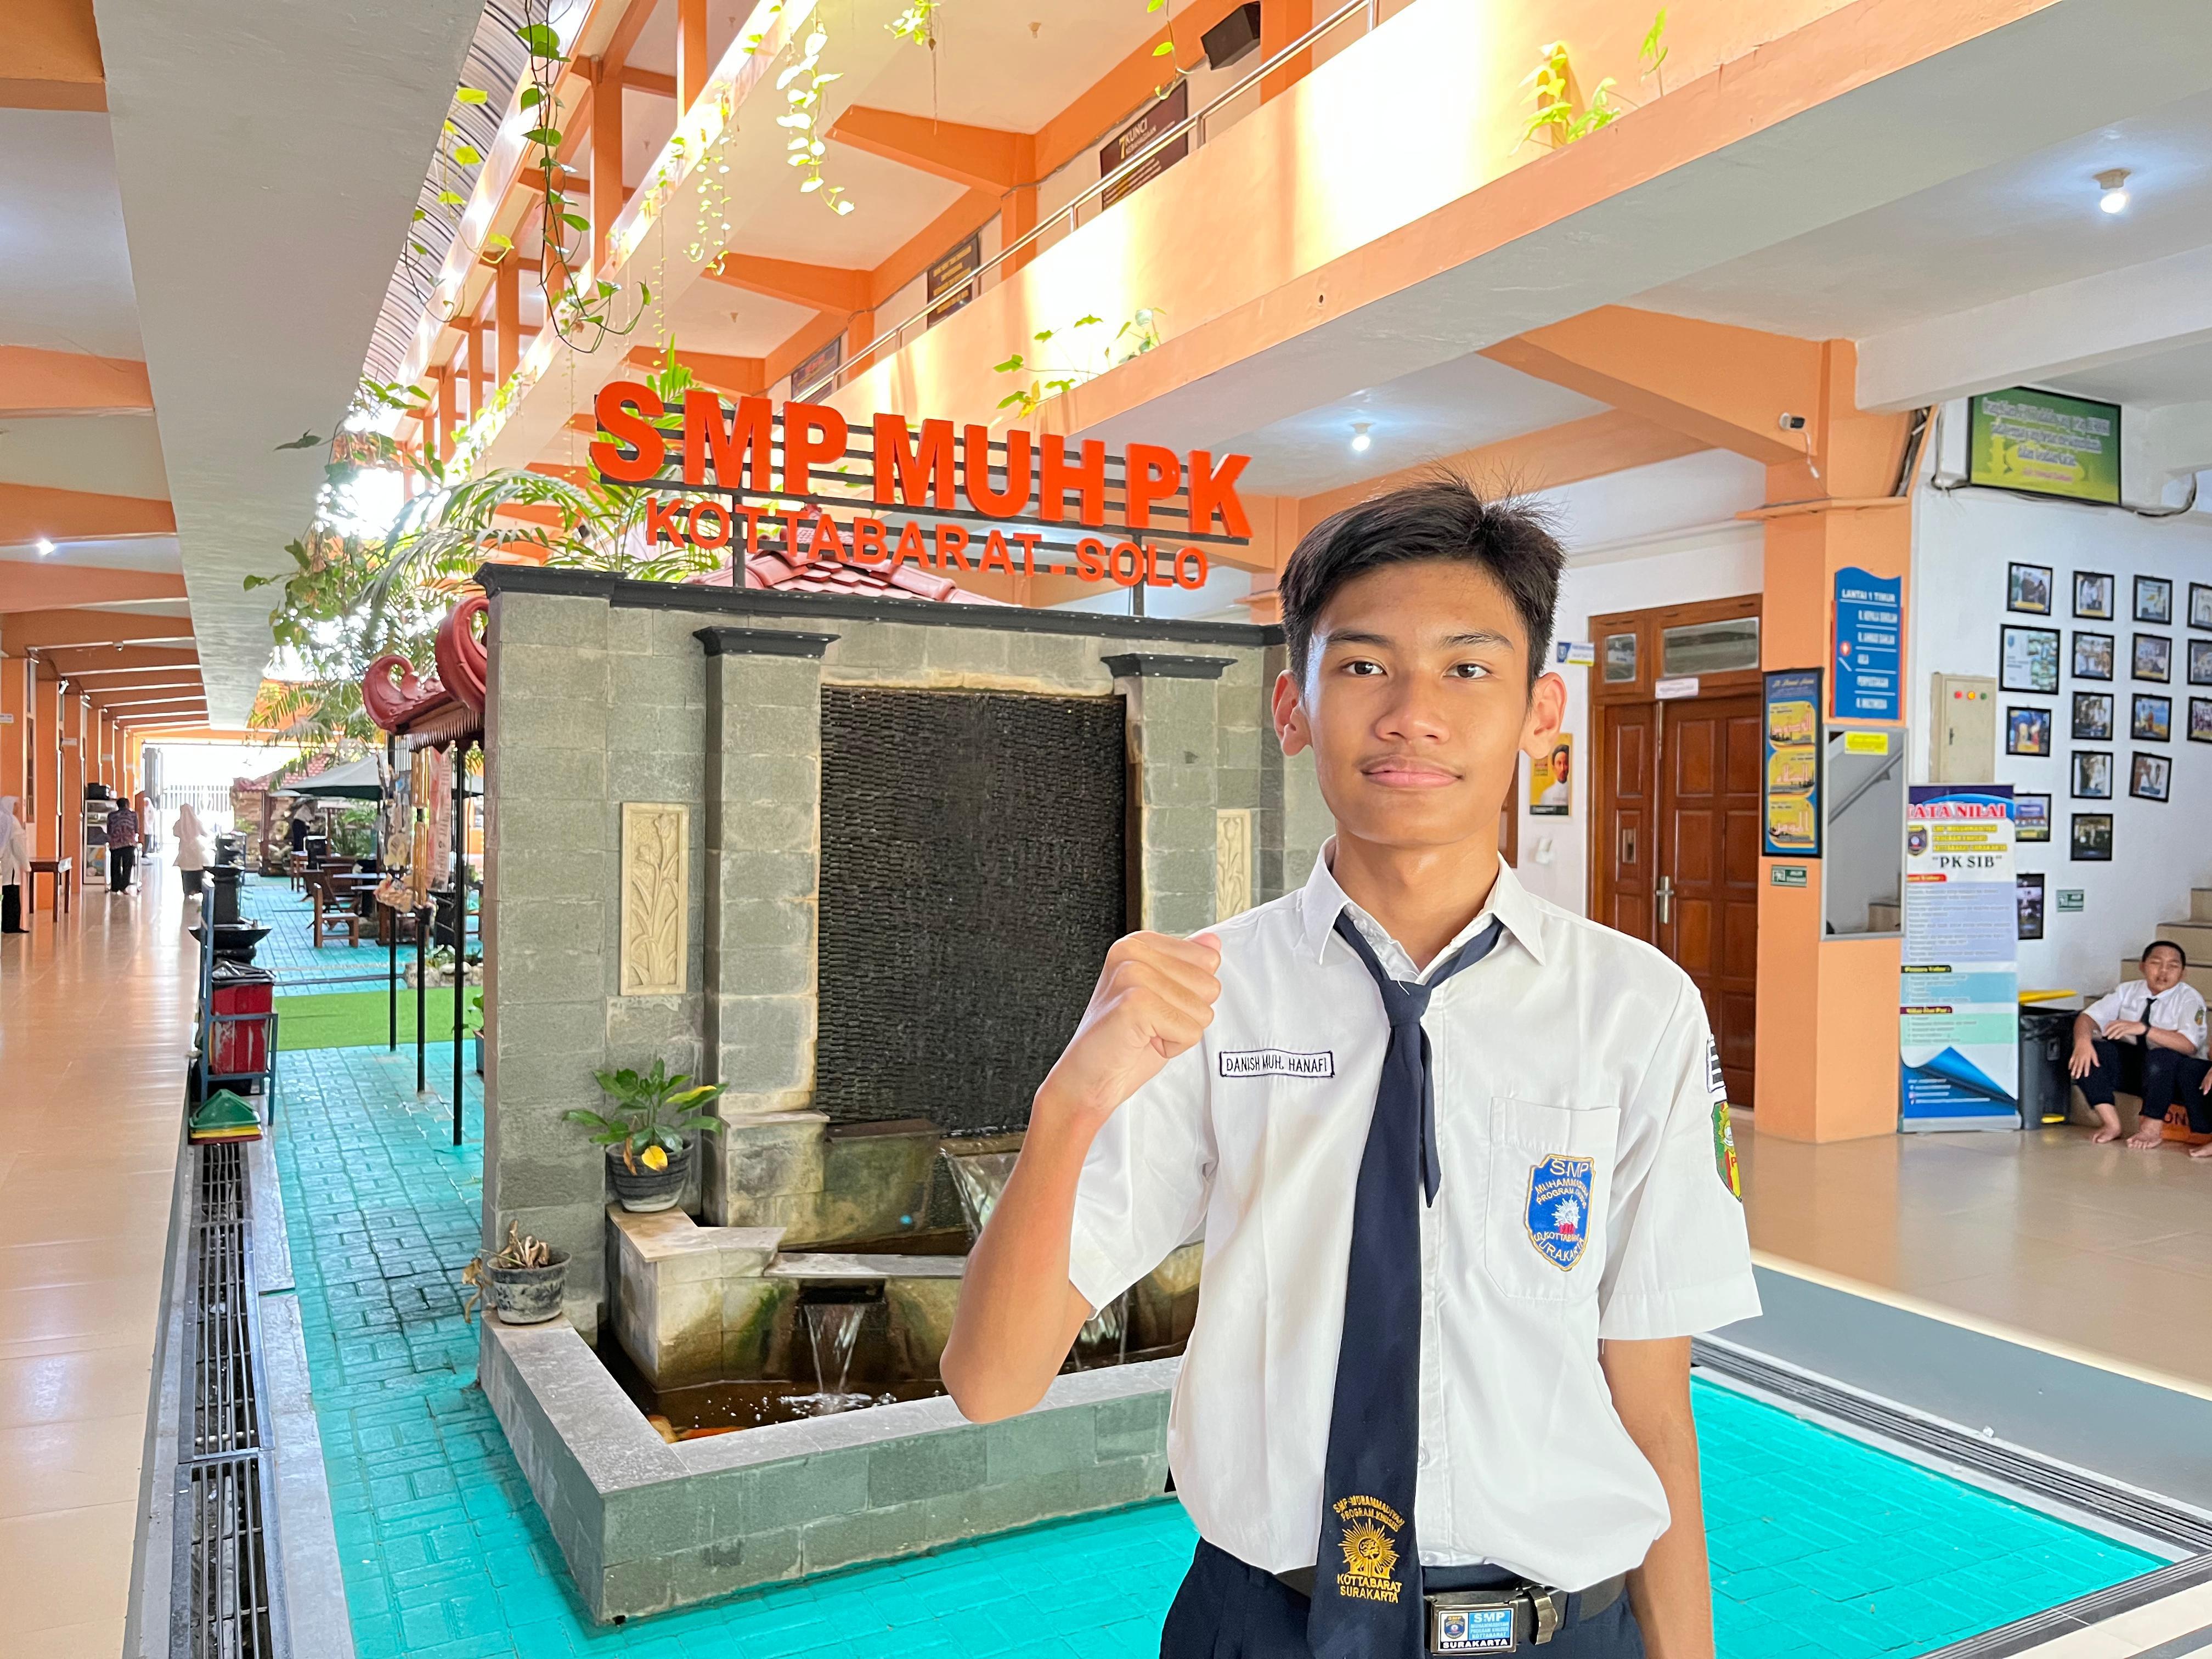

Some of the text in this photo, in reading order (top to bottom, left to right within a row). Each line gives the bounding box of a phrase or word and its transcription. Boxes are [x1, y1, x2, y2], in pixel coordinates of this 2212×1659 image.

[589, 381, 1254, 538] SMP MUH PK
[1076, 538, 1209, 590] SOLO
[1956, 804, 2006, 819] NILAI
[1227, 1057, 1260, 1073] DANISH
[1289, 1057, 1327, 1073] HANAFI
[1550, 1158, 1589, 1178] SMP
[1337, 1573, 1403, 1593] KOTTABARAT
[1340, 1585, 1398, 1604] SURAKARTA
[1474, 1612, 1505, 1623] SMP
[1443, 1638, 1508, 1649] SURAKARTA
